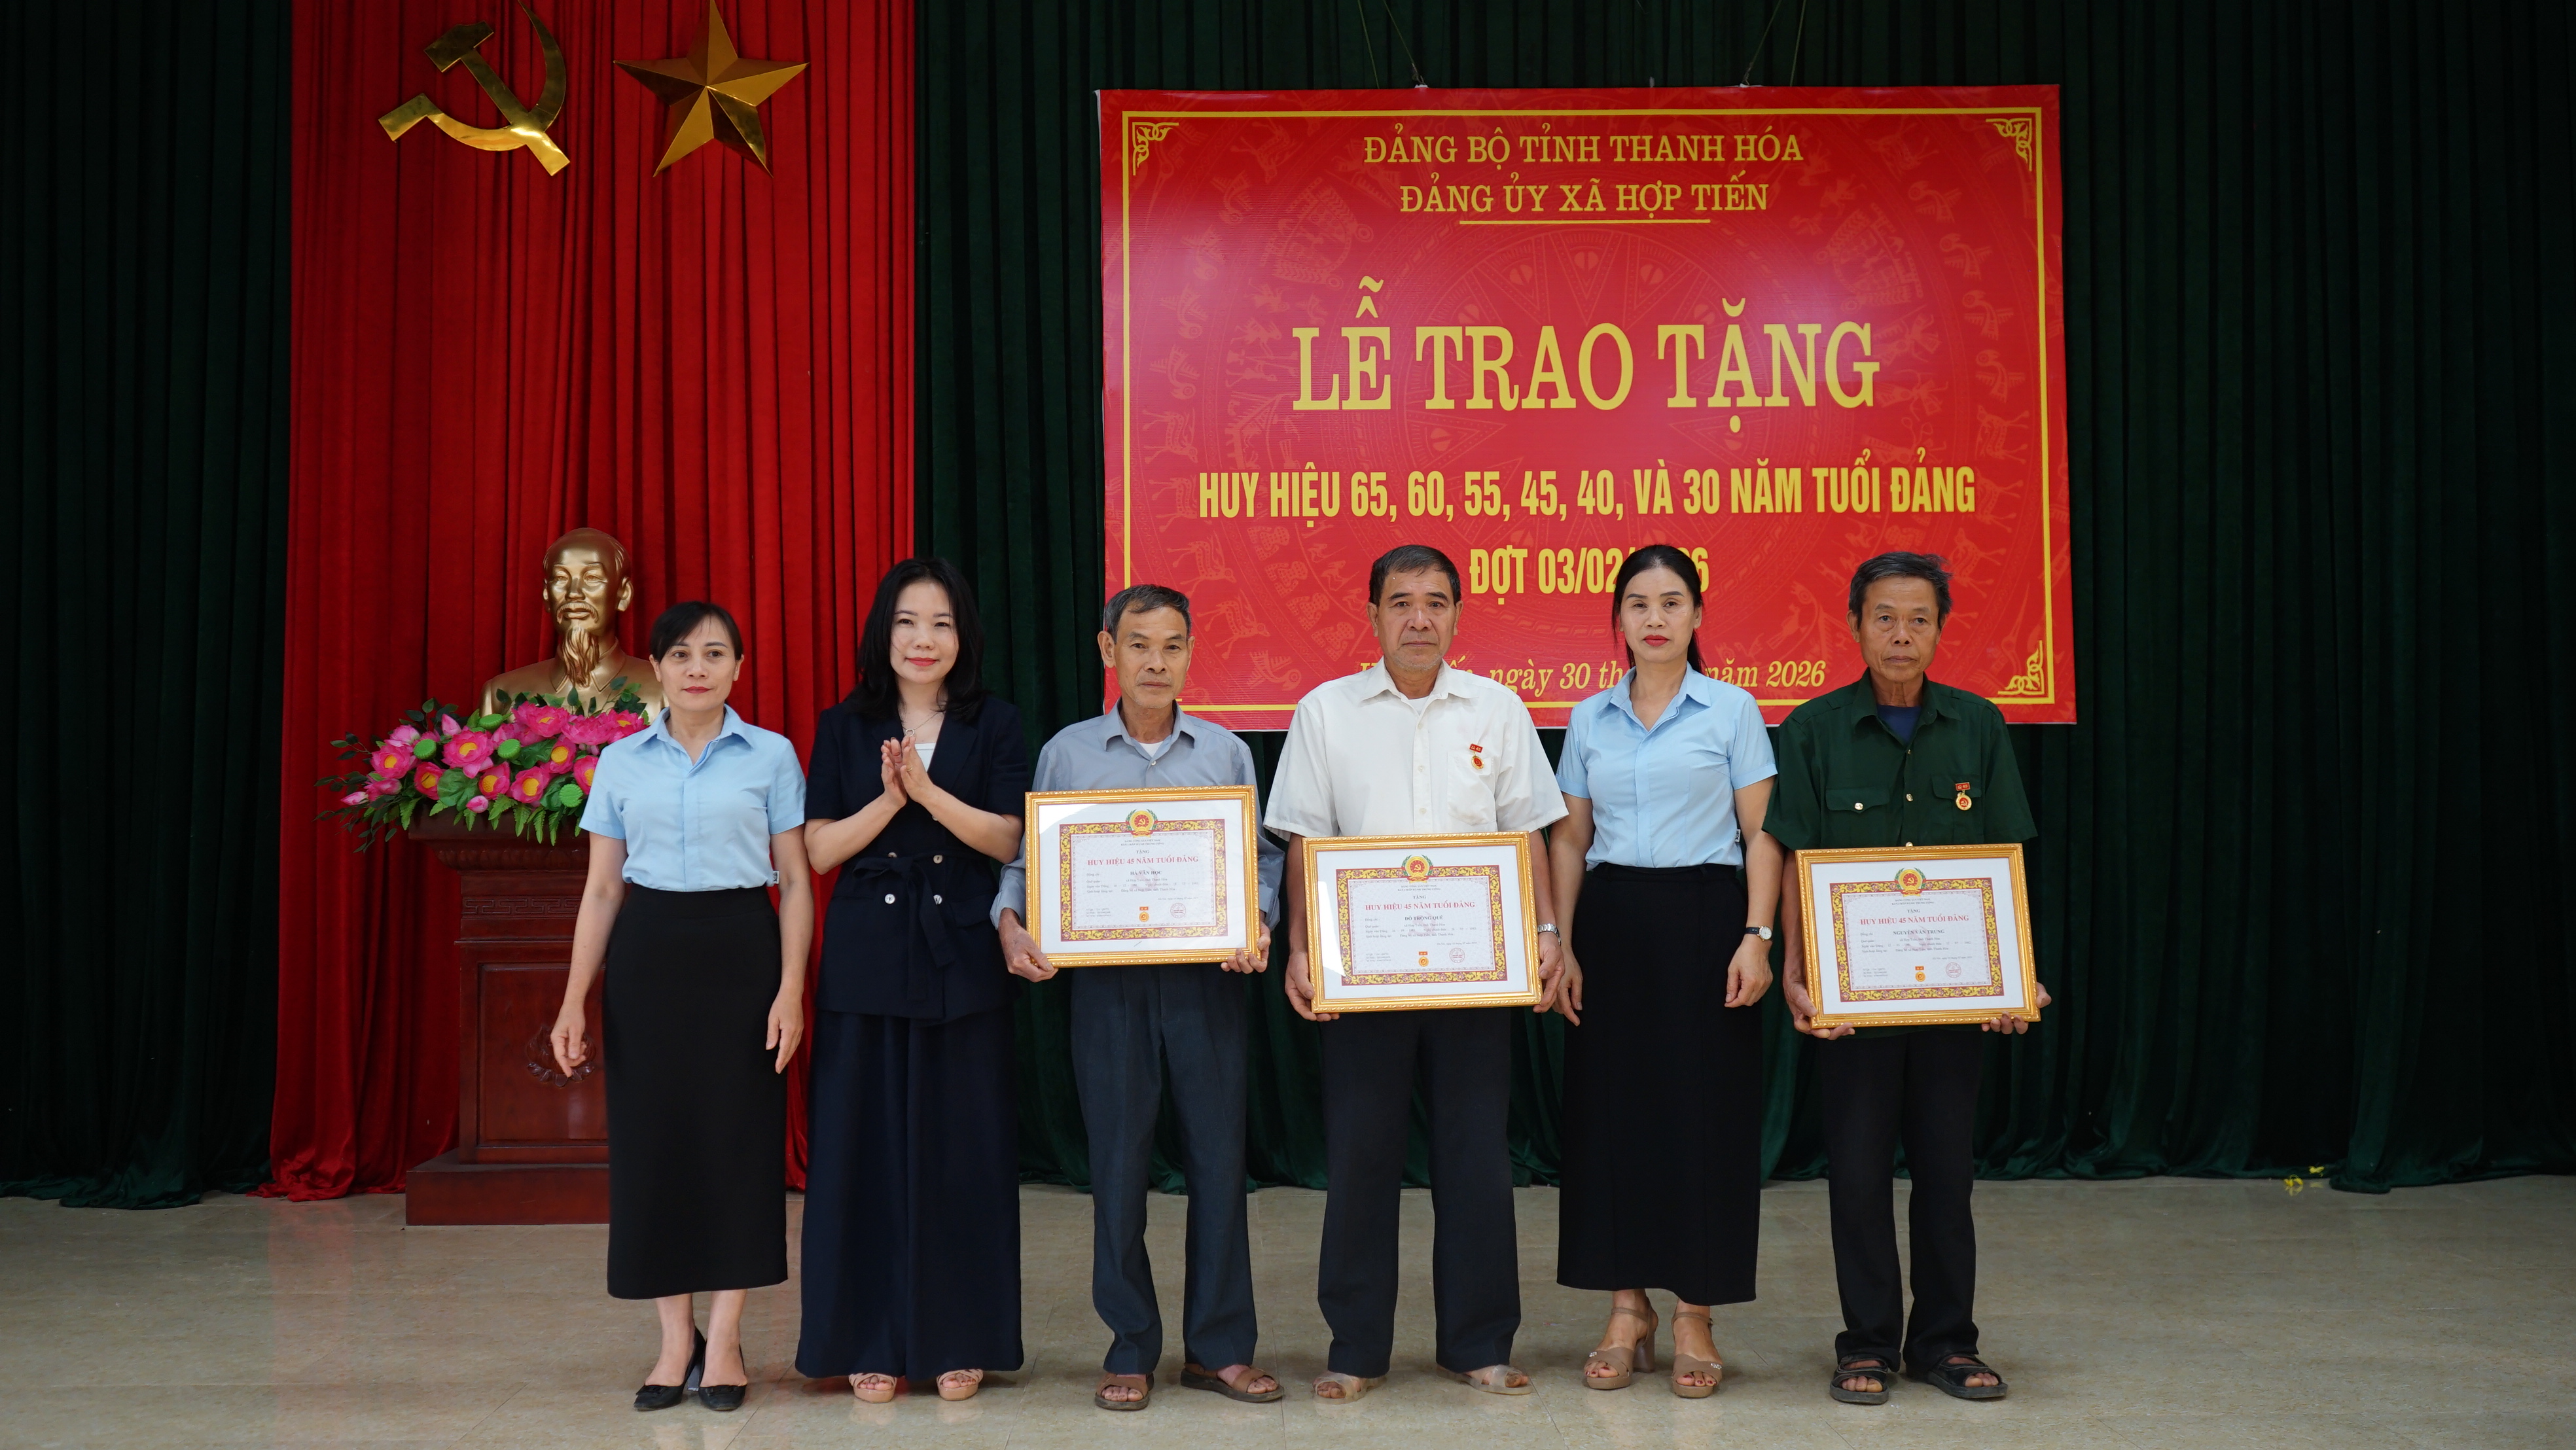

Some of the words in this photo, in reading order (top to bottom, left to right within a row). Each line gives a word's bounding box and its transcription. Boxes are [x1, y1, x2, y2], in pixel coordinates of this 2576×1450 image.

[1365, 123, 1458, 163] ĐẢNG
[1467, 127, 1510, 170] BỘ
[1520, 123, 1600, 162] TỈNH
[1610, 135, 1725, 162] THANH
[1734, 126, 1803, 161] HÓA
[1400, 172, 1494, 213] ĐẢNG
[1503, 172, 1548, 212] ỦY
[1559, 178, 1606, 211] XÃ
[1616, 181, 1681, 219] HỢP
[1691, 171, 1768, 211] TIẾN
[1293, 275, 1391, 410] LỄ
[1416, 323, 1634, 412] TRAO
[1657, 298, 1880, 433] TẶNG
[1199, 472, 1260, 518] HUY
[1270, 461, 1340, 528] HIỆU
[1351, 471, 1397, 522] 65,
[1408, 470, 1454, 522] 60,
[1464, 470, 1511, 522] 55,
[1520, 470, 1567, 522] 45,
[1577, 469, 1624, 521] 40,
[1633, 459, 1674, 514] VÀ
[1683, 469, 1720, 514] 30
[1730, 457, 1802, 514] NĂM
[1812, 448, 1880, 513] TUỔI
[1889, 447, 1975, 513] ĐẢNG
[1469, 544, 1528, 605] ĐỢT
[1490, 658, 1554, 698] ngày
[1560, 662, 1591, 689] 30
[1766, 660, 1827, 688] 2026
[1106, 857, 1125, 866] HIỆU
[1384, 902, 1403, 911] HIỆU
[1878, 916, 1897, 926] HIỆU
[1948, 913, 1969, 922] ĐẢNG
